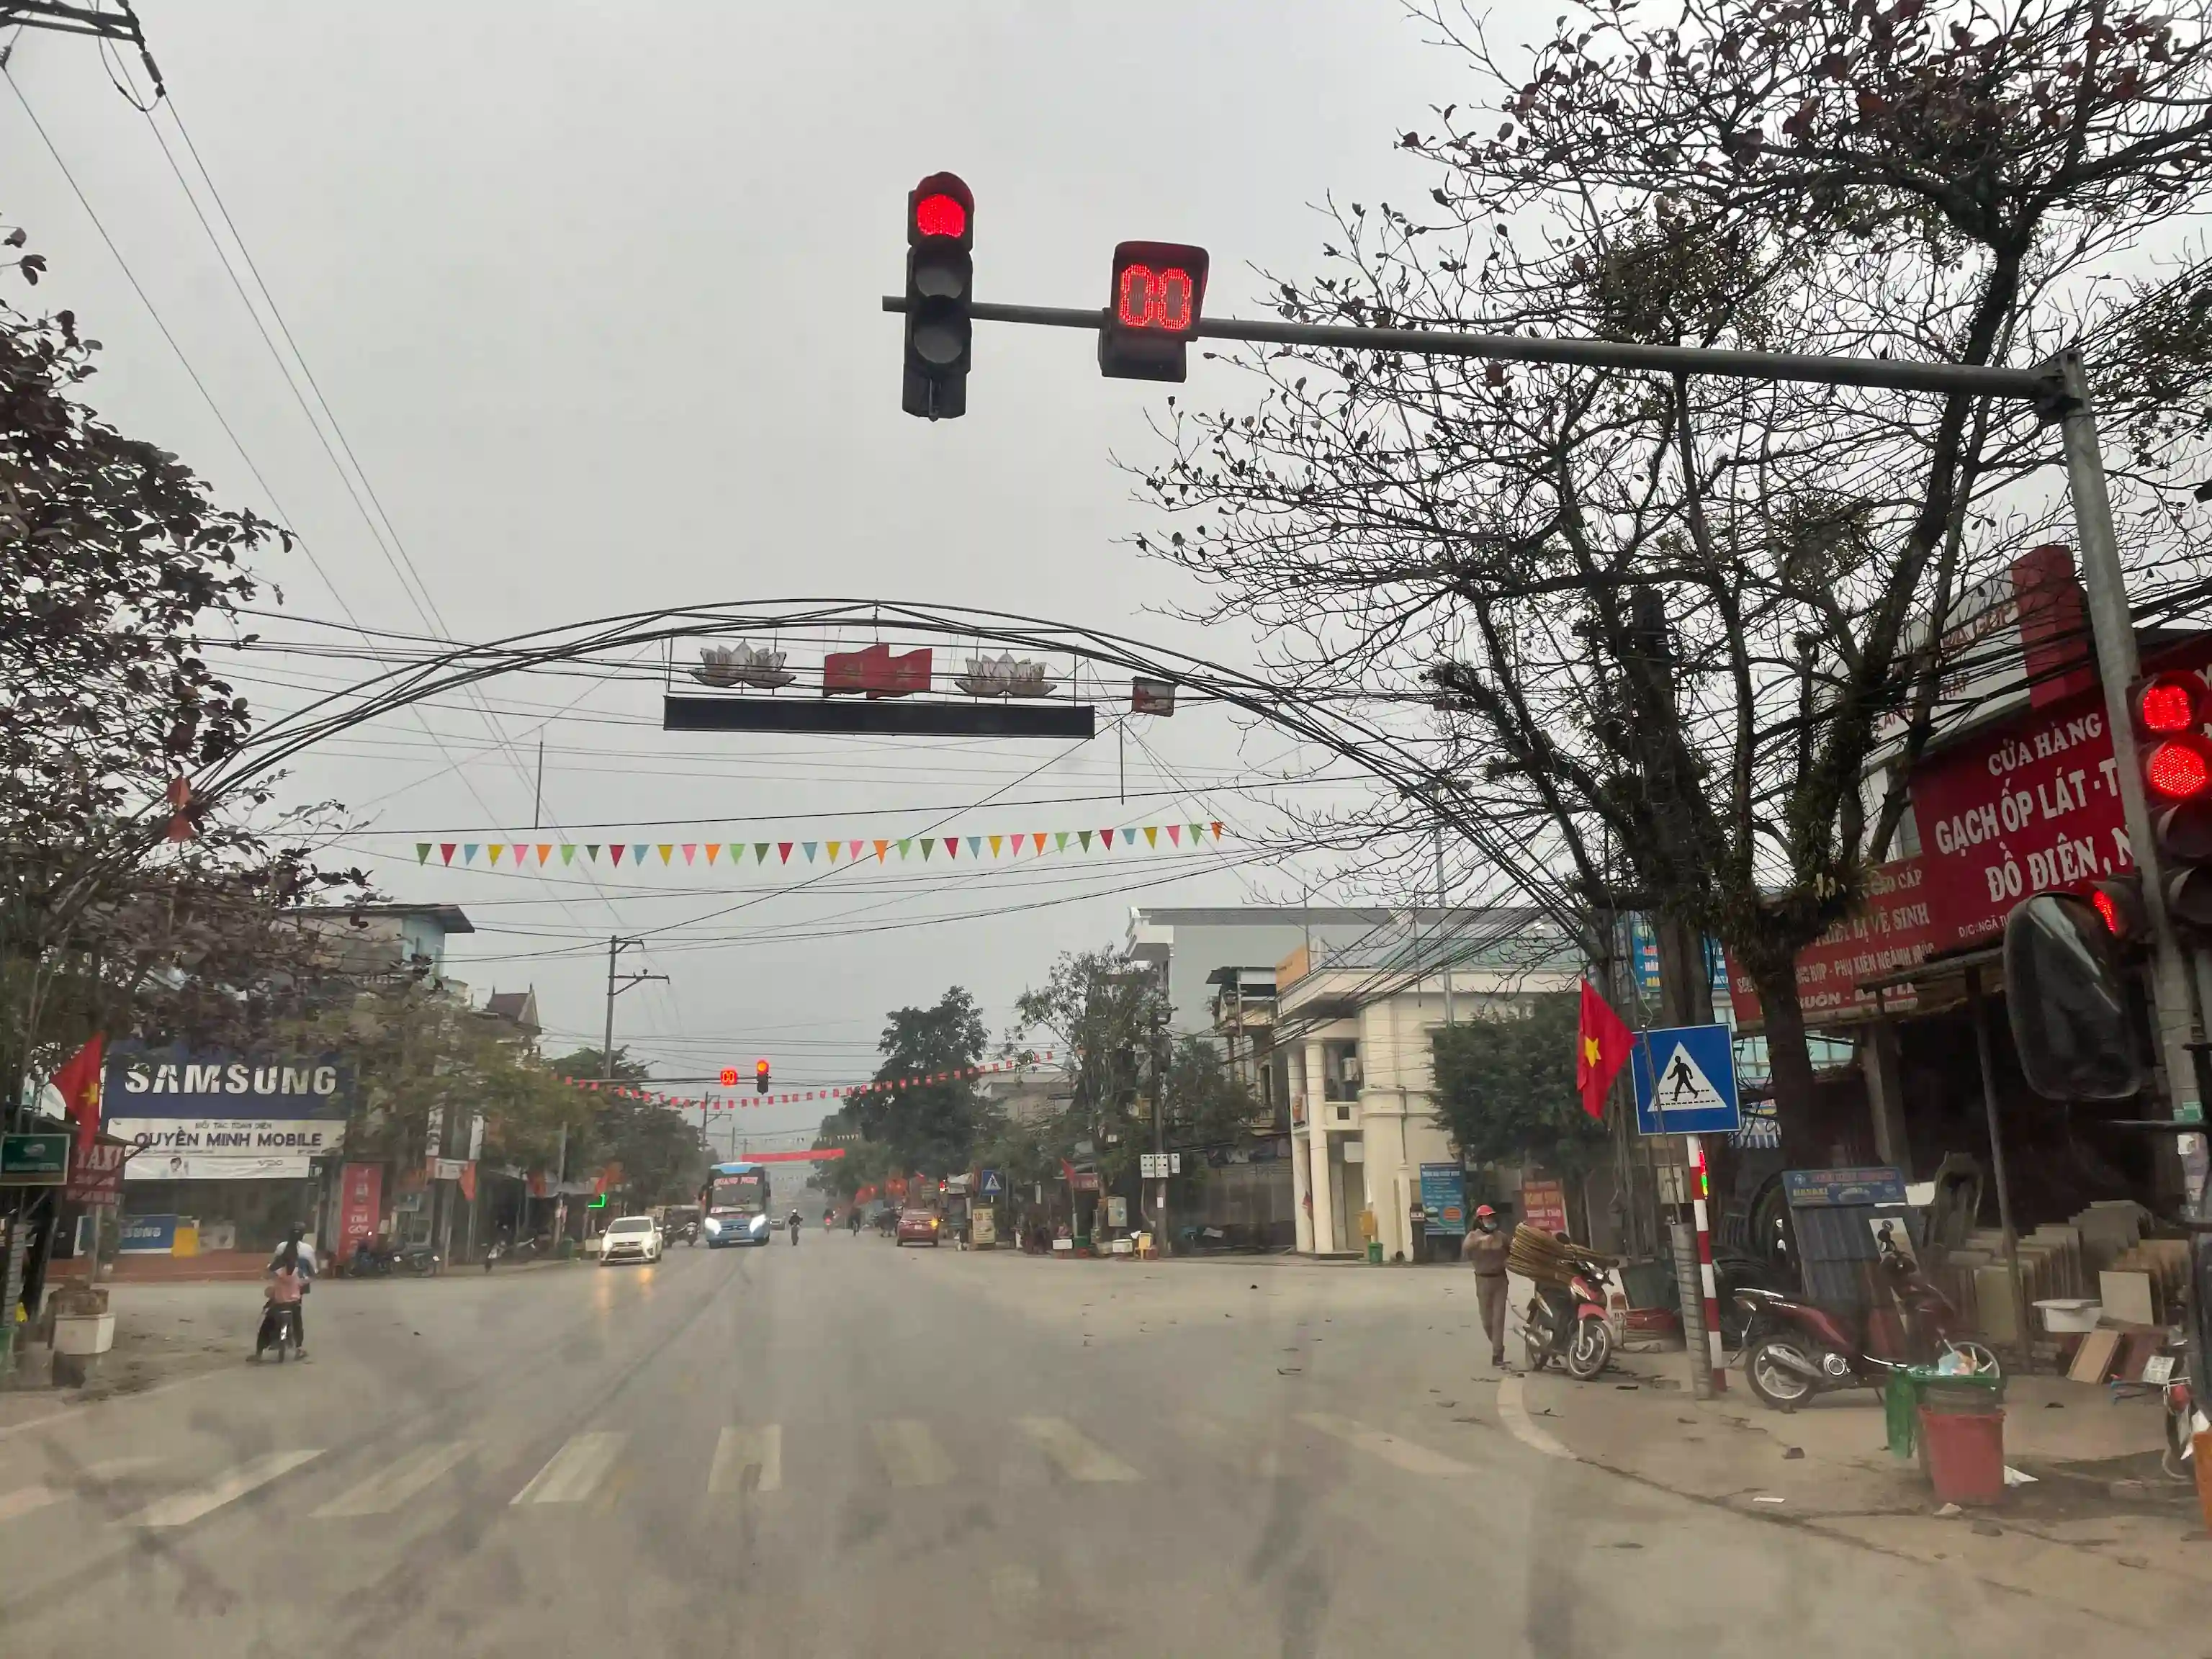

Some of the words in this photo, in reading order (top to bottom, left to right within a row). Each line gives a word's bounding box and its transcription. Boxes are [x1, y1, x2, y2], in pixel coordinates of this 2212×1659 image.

[1120, 264, 1192, 329] 00
[1988, 739, 2033, 776] CỬA
[2034, 713, 2102, 759] HÀNG
[1936, 802, 2000, 857] GẠCH
[2001, 778, 2033, 832] ỐP
[2038, 766, 2087, 819] LÁT
[1985, 841, 2023, 902] ĐỒ
[1892, 902, 1930, 931] SINH
[125, 1063, 337, 1094] SAMSUNG
[206, 1133, 251, 1146] MINH
[257, 1133, 322, 1146] MOBILE
